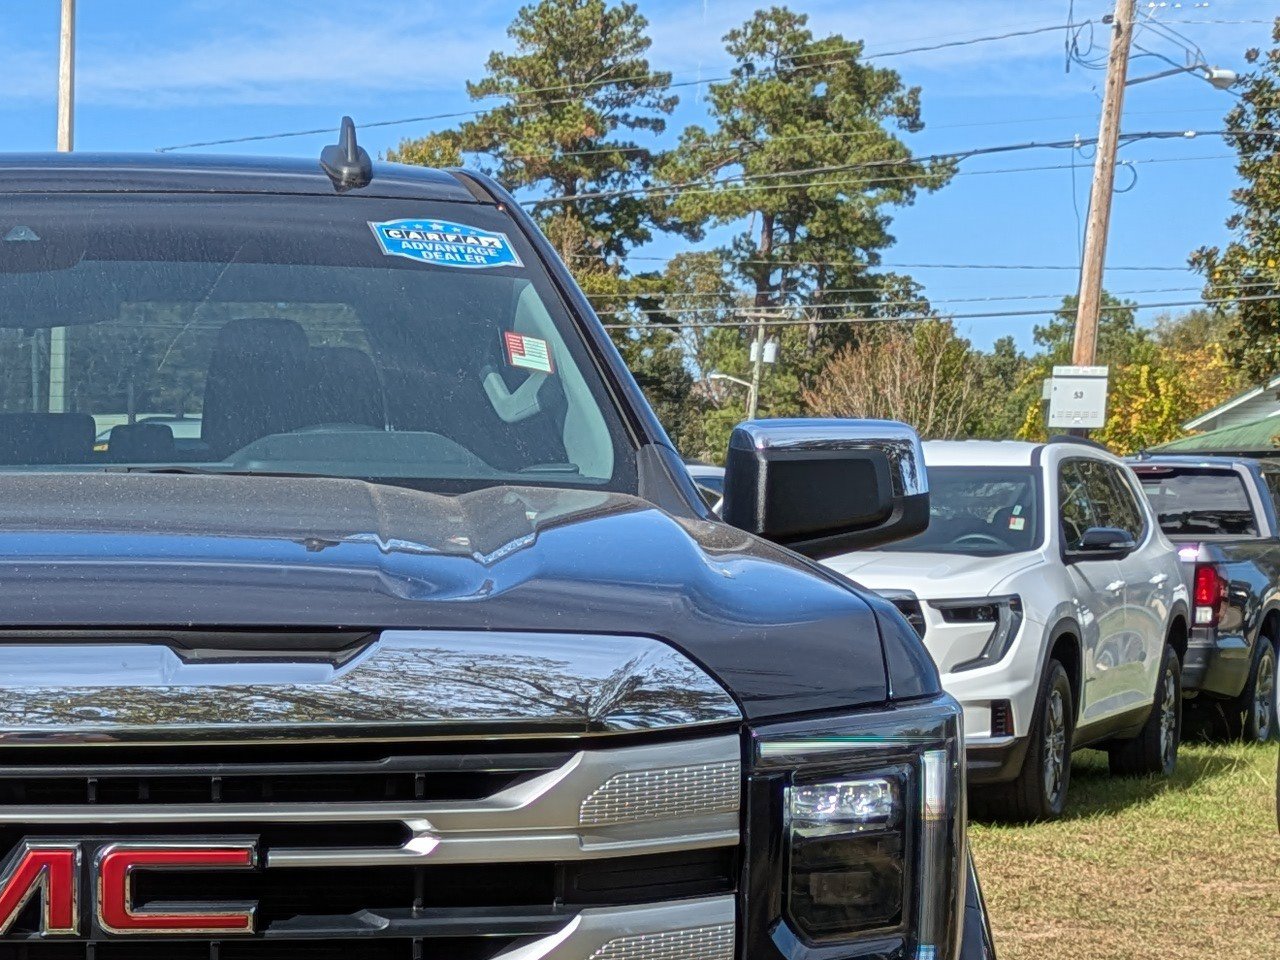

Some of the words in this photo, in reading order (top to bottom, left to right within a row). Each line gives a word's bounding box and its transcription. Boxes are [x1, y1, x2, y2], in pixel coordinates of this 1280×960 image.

[385, 229, 503, 249] CARFAX
[401, 241, 500, 257] ADVANTAGE
[421, 250, 488, 264] DEALER
